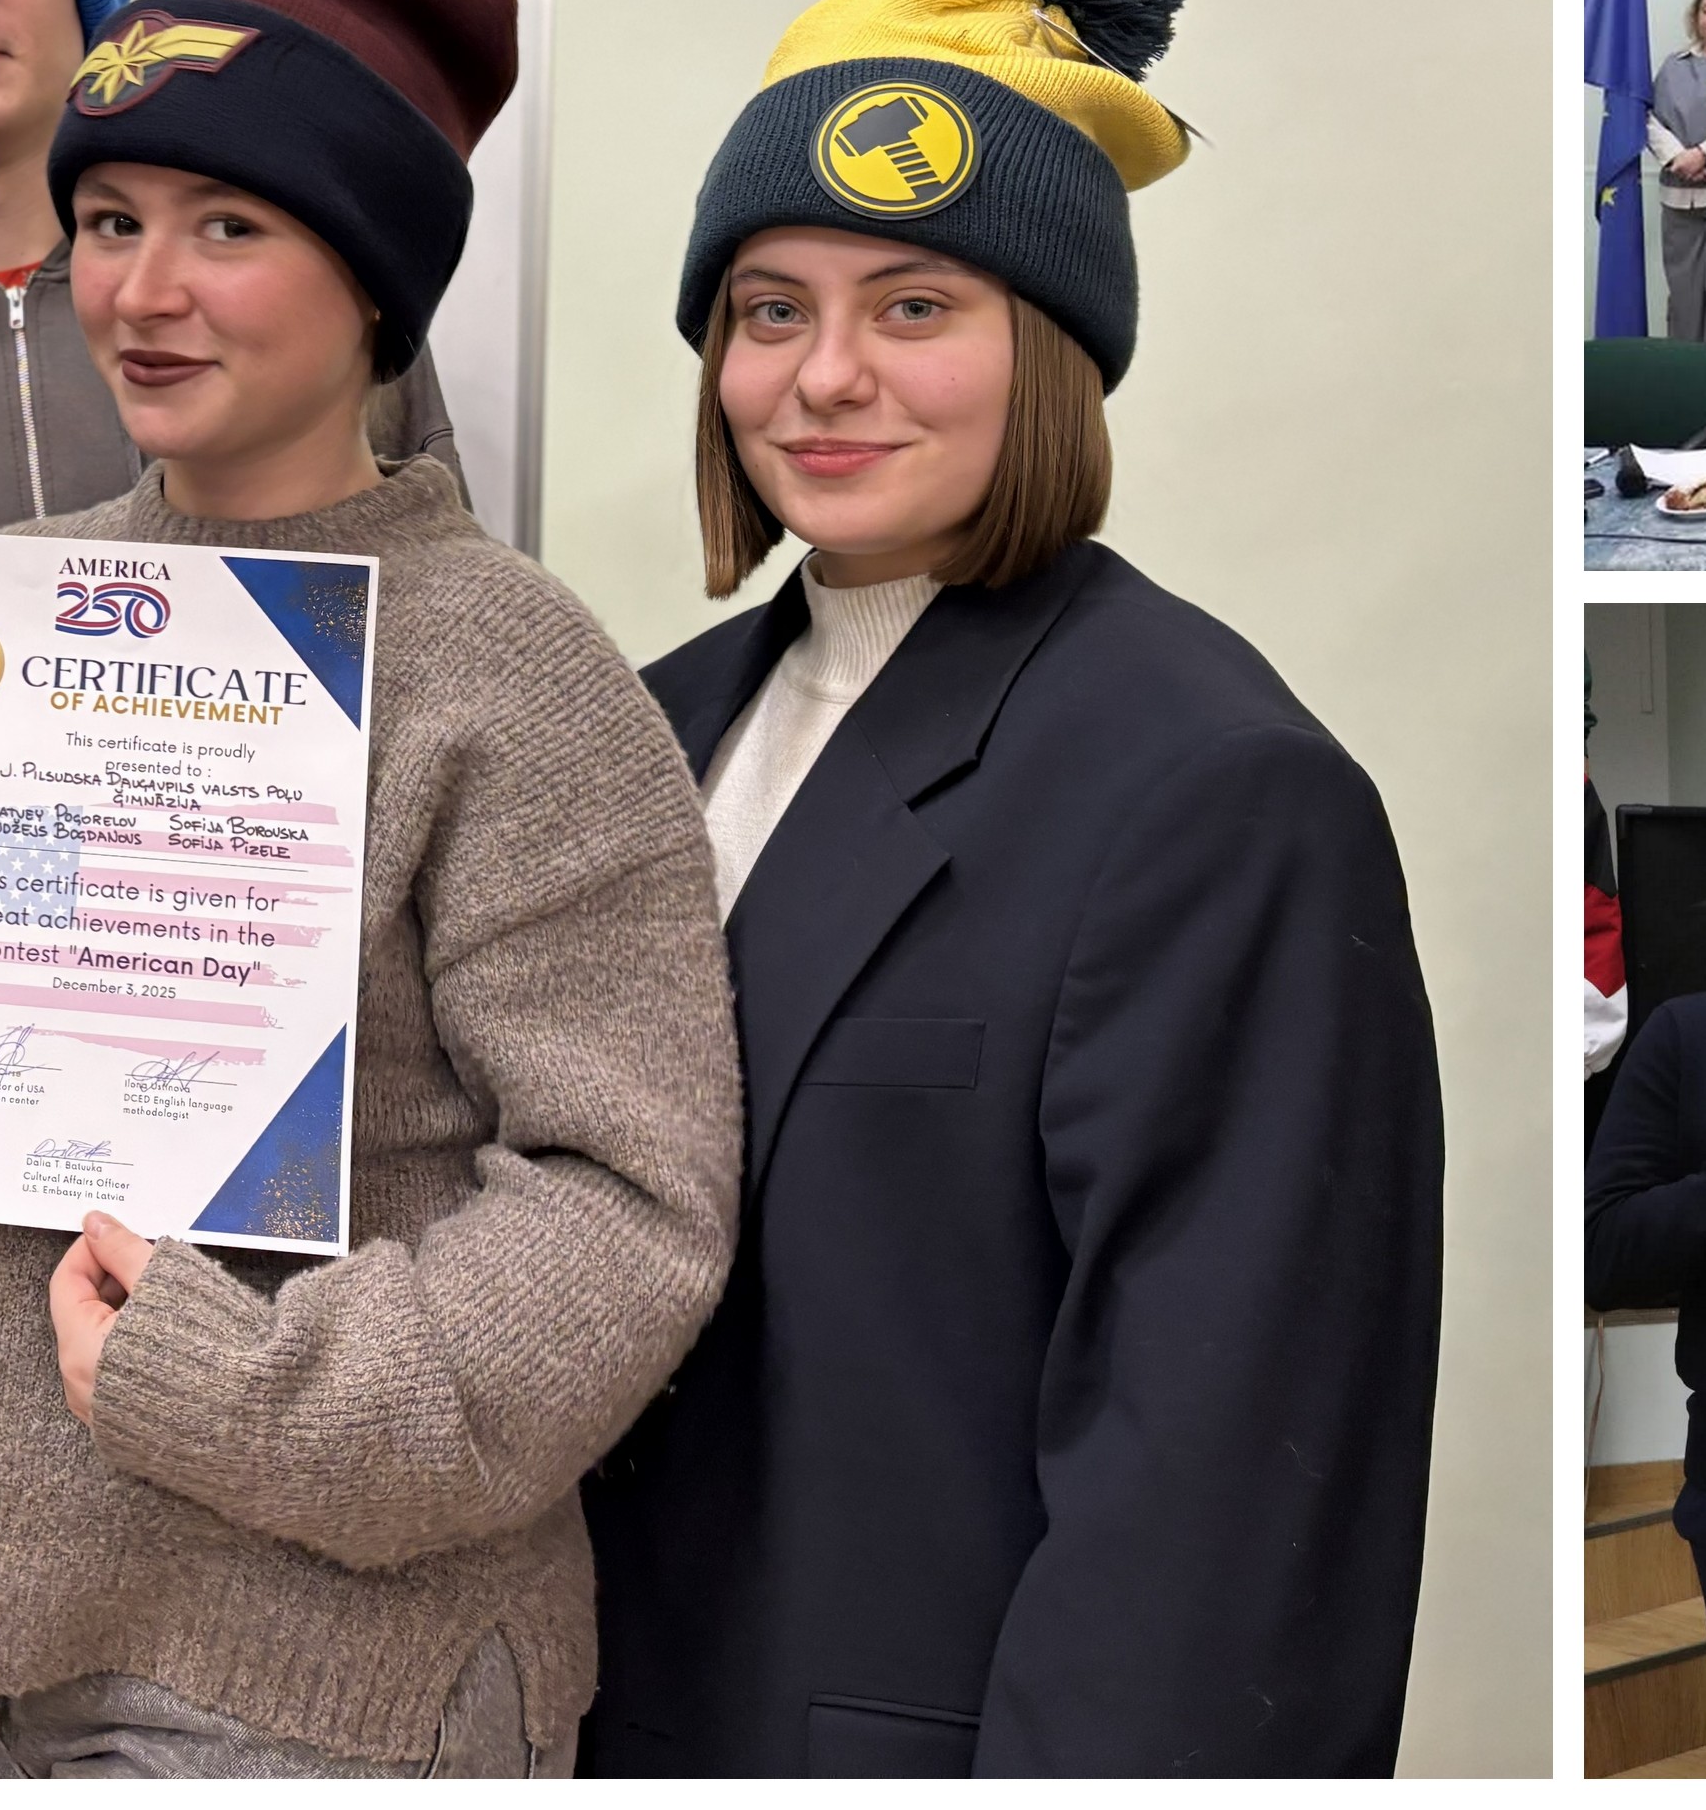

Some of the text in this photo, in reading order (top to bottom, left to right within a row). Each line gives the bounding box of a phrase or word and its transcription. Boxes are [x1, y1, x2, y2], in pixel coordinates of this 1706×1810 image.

[58, 557, 172, 582] AMERICA
[54, 581, 172, 639] 250
[21, 655, 309, 706] CERTIFICATE
[50, 692, 284, 726] OF ACHIEVEMENT
[65, 732, 257, 763] This certificate is proudly
[22, 762, 102, 786] PILSUDSKA
[105, 759, 176, 780] presented
[179, 762, 203, 779] to
[15, 873, 140, 903] certificate
[148, 883, 165, 901] is
[172, 885, 237, 912] given
[246, 887, 280, 913] for
[37, 910, 201, 943] achievements
[209, 920, 230, 943] in
[237, 924, 276, 948] the
[69, 946, 194, 977] "American
[203, 957, 260, 987] Day"
[52, 977, 177, 1000] December 3, 2025
[14, 1083, 24, 1092] of
[27, 1084, 45, 1093] USA
[9, 1097, 39, 1105] center
[124, 1093, 233, 1113] DCED English language
[26, 1157, 51, 1167] Dalia
[55, 1160, 61, 1168] T.
[22, 1184, 125, 1201] U.S. Embassy in Latvia
[23, 1172, 130, 1189] Cultural Affairs Officer
